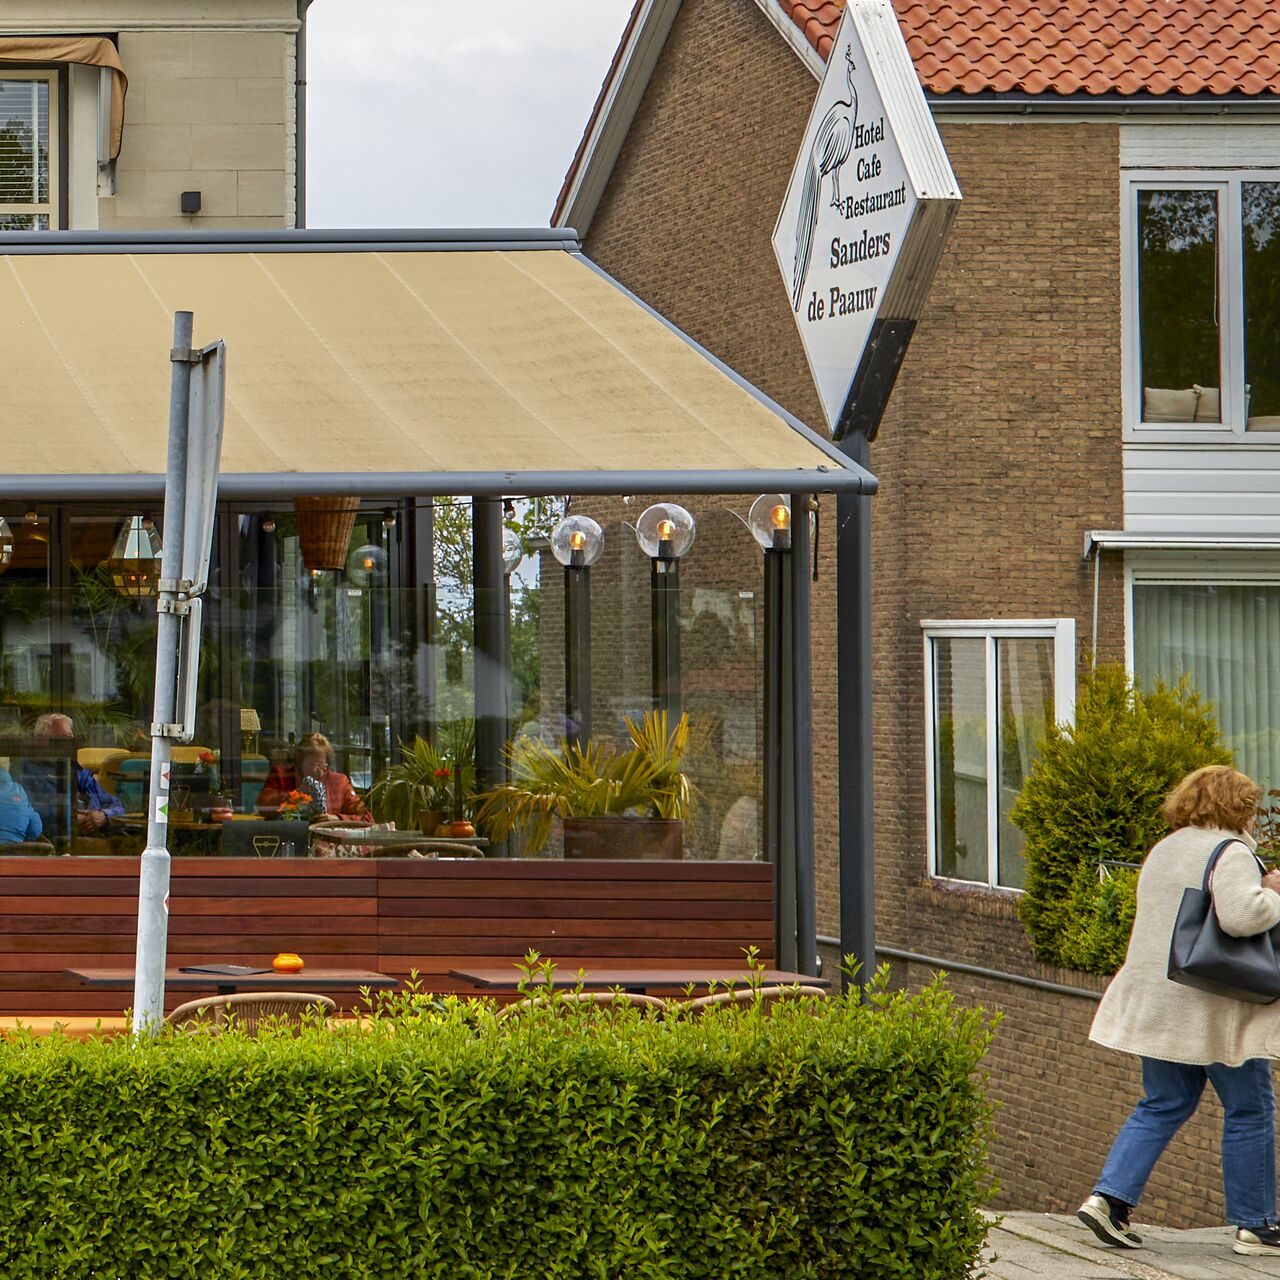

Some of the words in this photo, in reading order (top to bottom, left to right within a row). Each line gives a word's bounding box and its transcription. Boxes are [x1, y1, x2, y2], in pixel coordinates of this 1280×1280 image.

[854, 117, 884, 149] Hotel
[857, 154, 882, 181] Cafe
[845, 182, 906, 219] Restaurant
[830, 230, 891, 268] Sanders
[807, 293, 824, 322] de
[828, 285, 876, 317] Paauw
